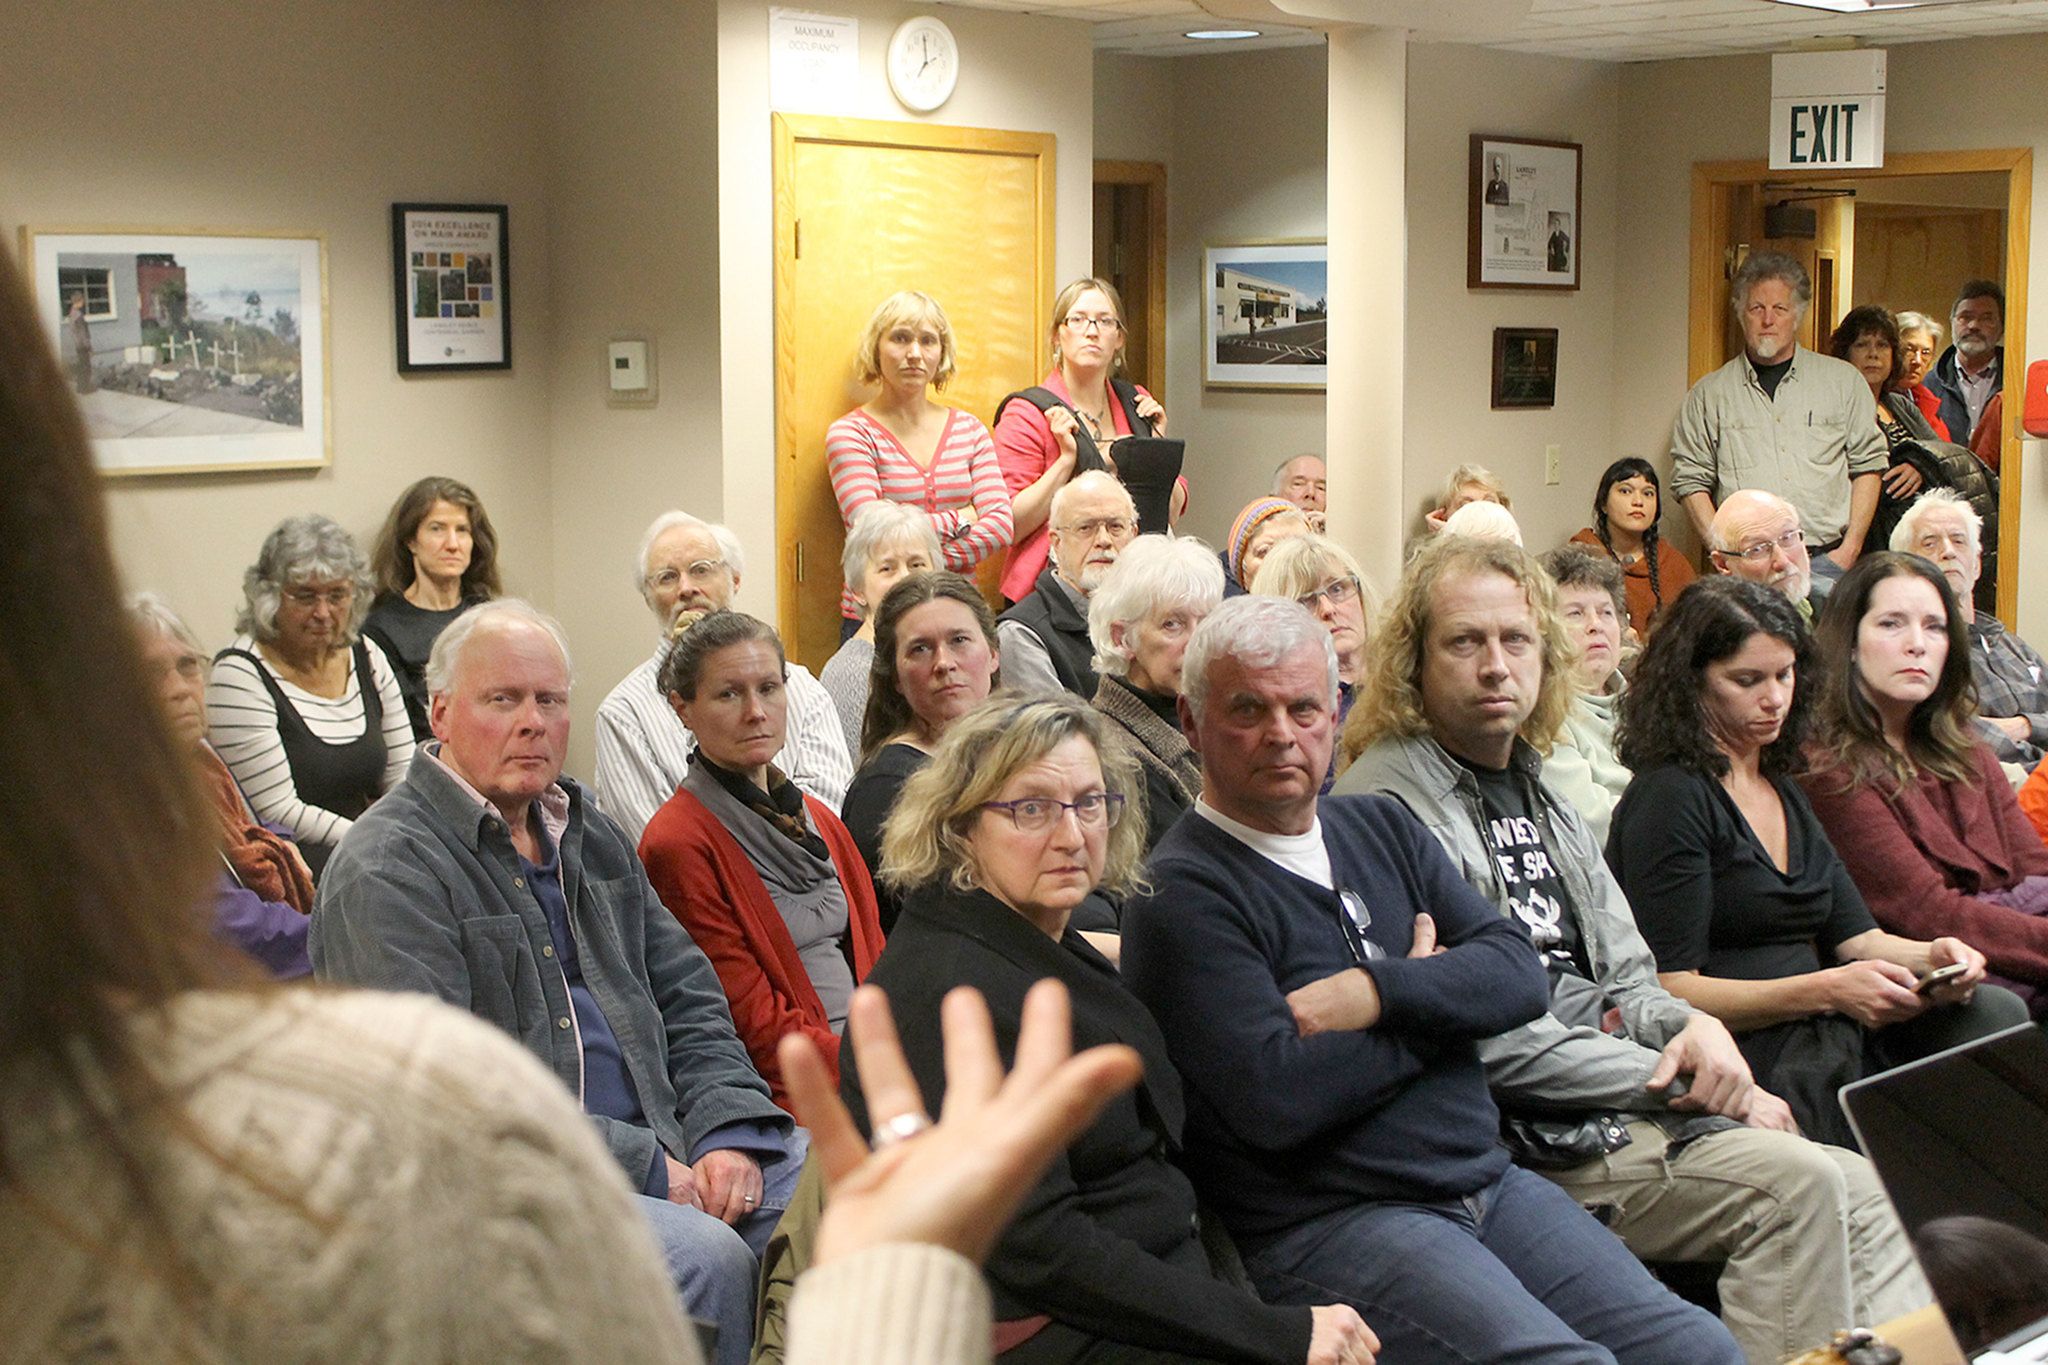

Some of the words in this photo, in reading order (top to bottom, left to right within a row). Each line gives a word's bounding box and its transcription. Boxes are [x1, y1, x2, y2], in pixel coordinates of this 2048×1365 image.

[794, 26, 834, 38] MAXIMUM
[788, 39, 840, 54] OCCUPANCY
[1790, 104, 1859, 163] EXIT
[411, 220, 431, 229] 2014
[434, 220, 491, 231] EXCELLENCE
[414, 230, 425, 238] ON
[456, 230, 489, 239] AWARD
